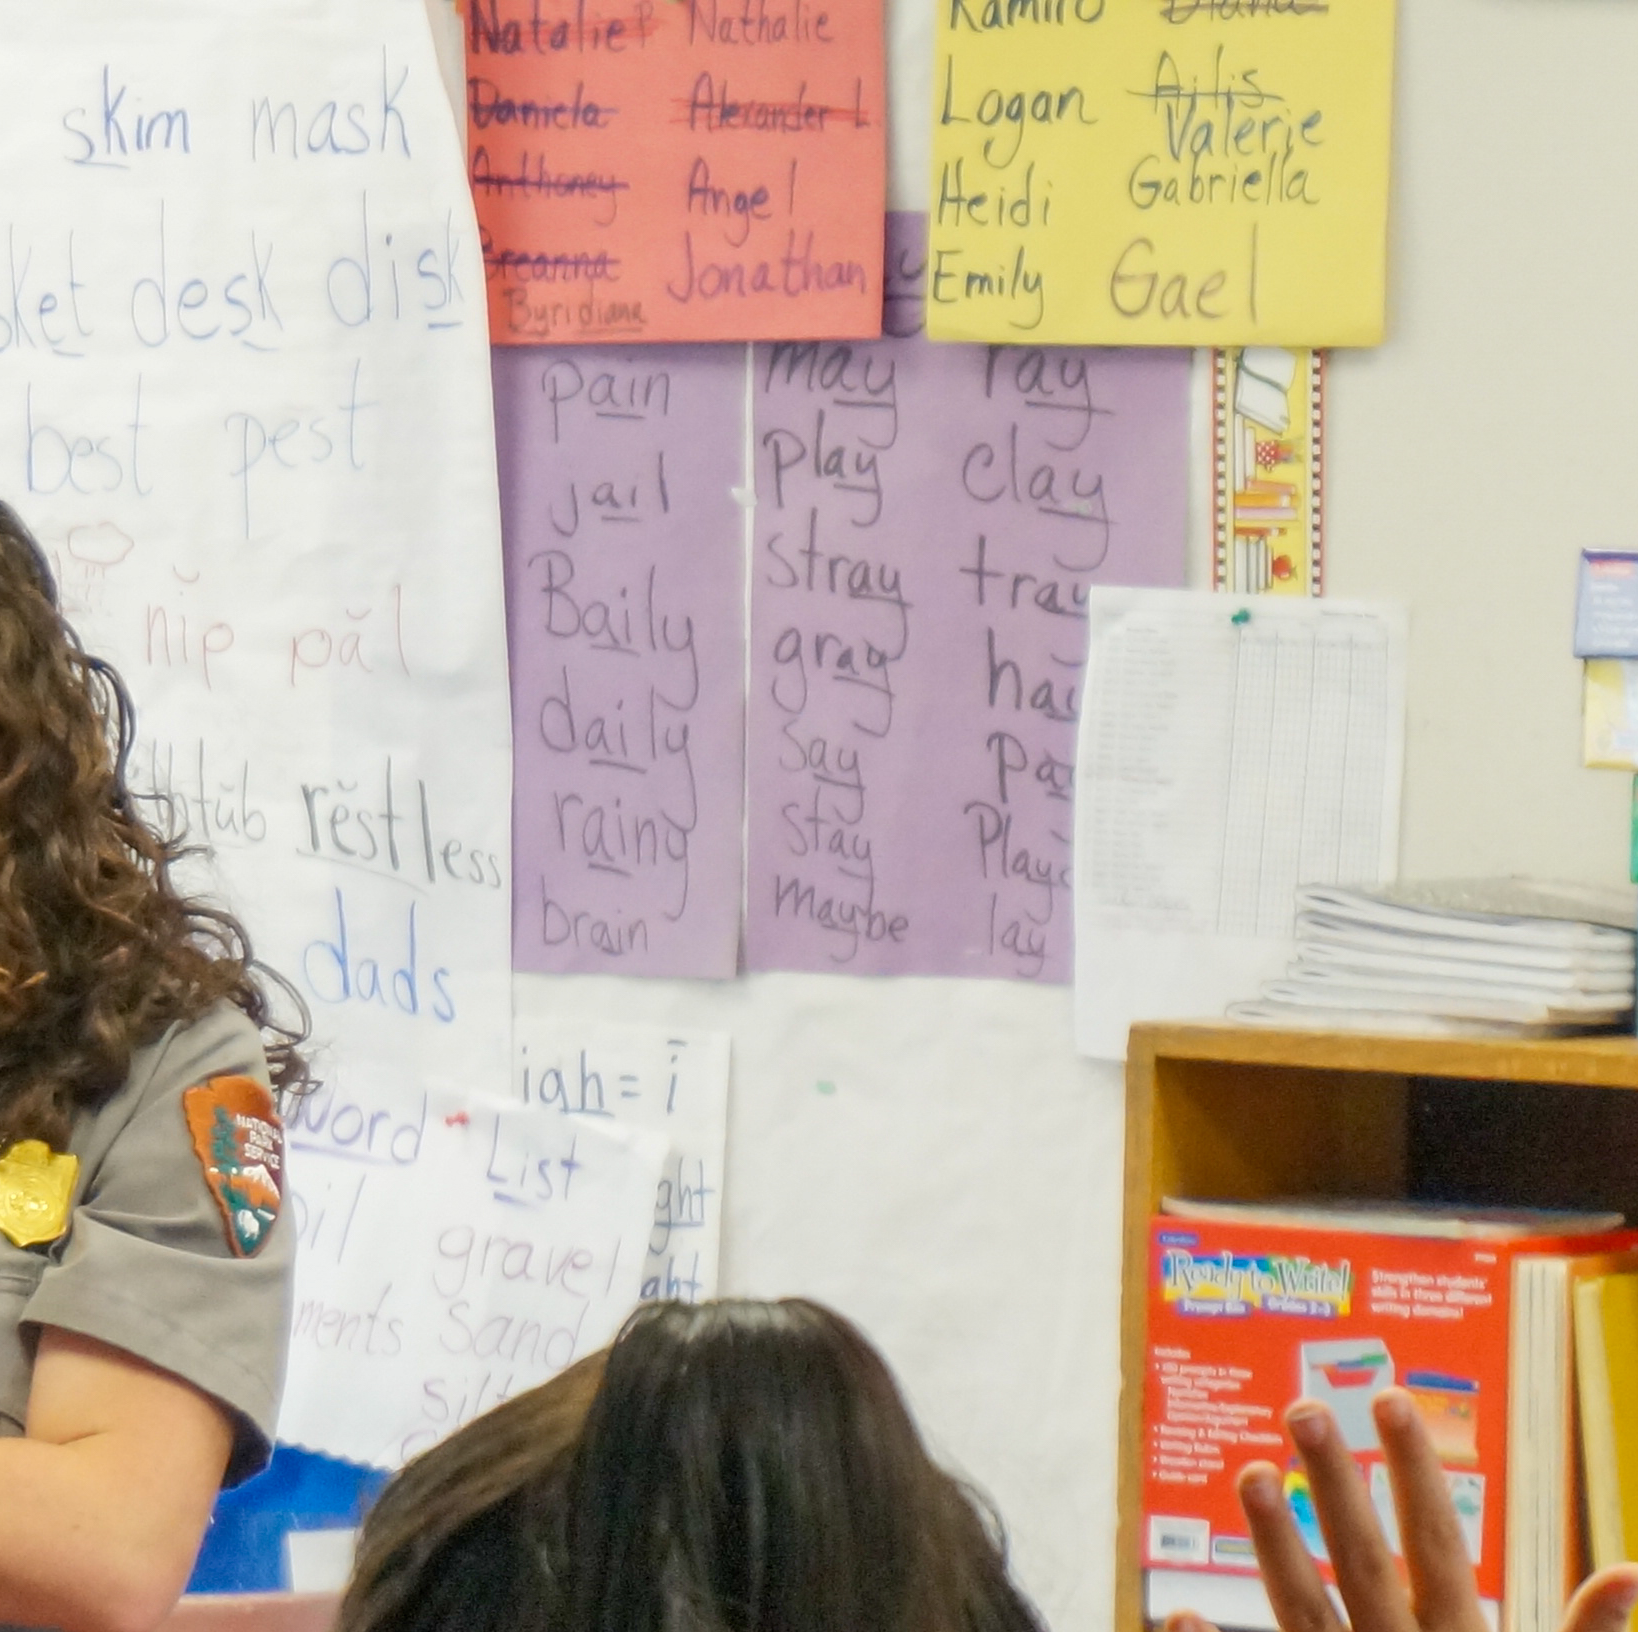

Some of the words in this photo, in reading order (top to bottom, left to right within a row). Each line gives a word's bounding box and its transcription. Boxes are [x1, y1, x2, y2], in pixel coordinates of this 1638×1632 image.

[685, 0, 833, 46] Nathalie
[63, 64, 190, 161] skim
[252, 43, 411, 161] mask
[940, 54, 1098, 168] Logan
[1166, 98, 1324, 161] Valerie
[687, 156, 799, 248] Angel
[938, 157, 1053, 228] Heidi
[1129, 154, 1320, 209] Gabriella
[131, 198, 283, 349] desk
[326, 189, 465, 328] disk
[668, 229, 868, 304] Jonathan
[934, 245, 1044, 330] Emily
[1110, 222, 1259, 325] Gael
[25, 380, 151, 496] best
[541, 359, 670, 443] pain
[763, 409, 882, 526] play
[528, 550, 699, 710] Baily
[540, 665, 697, 832] daily
[303, 886, 455, 1023] dads
[541, 874, 648, 956] brain
[236, 1113, 283, 1144] NATIONAL
[244, 1142, 281, 1169] SERVICE
[250, 1130, 274, 1151] PARK
[486, 1112, 582, 1201] List
[433, 1225, 621, 1298] gravel
[1166, 1248, 1246, 1303] Ready
[1269, 1256, 1352, 1301] Write!
